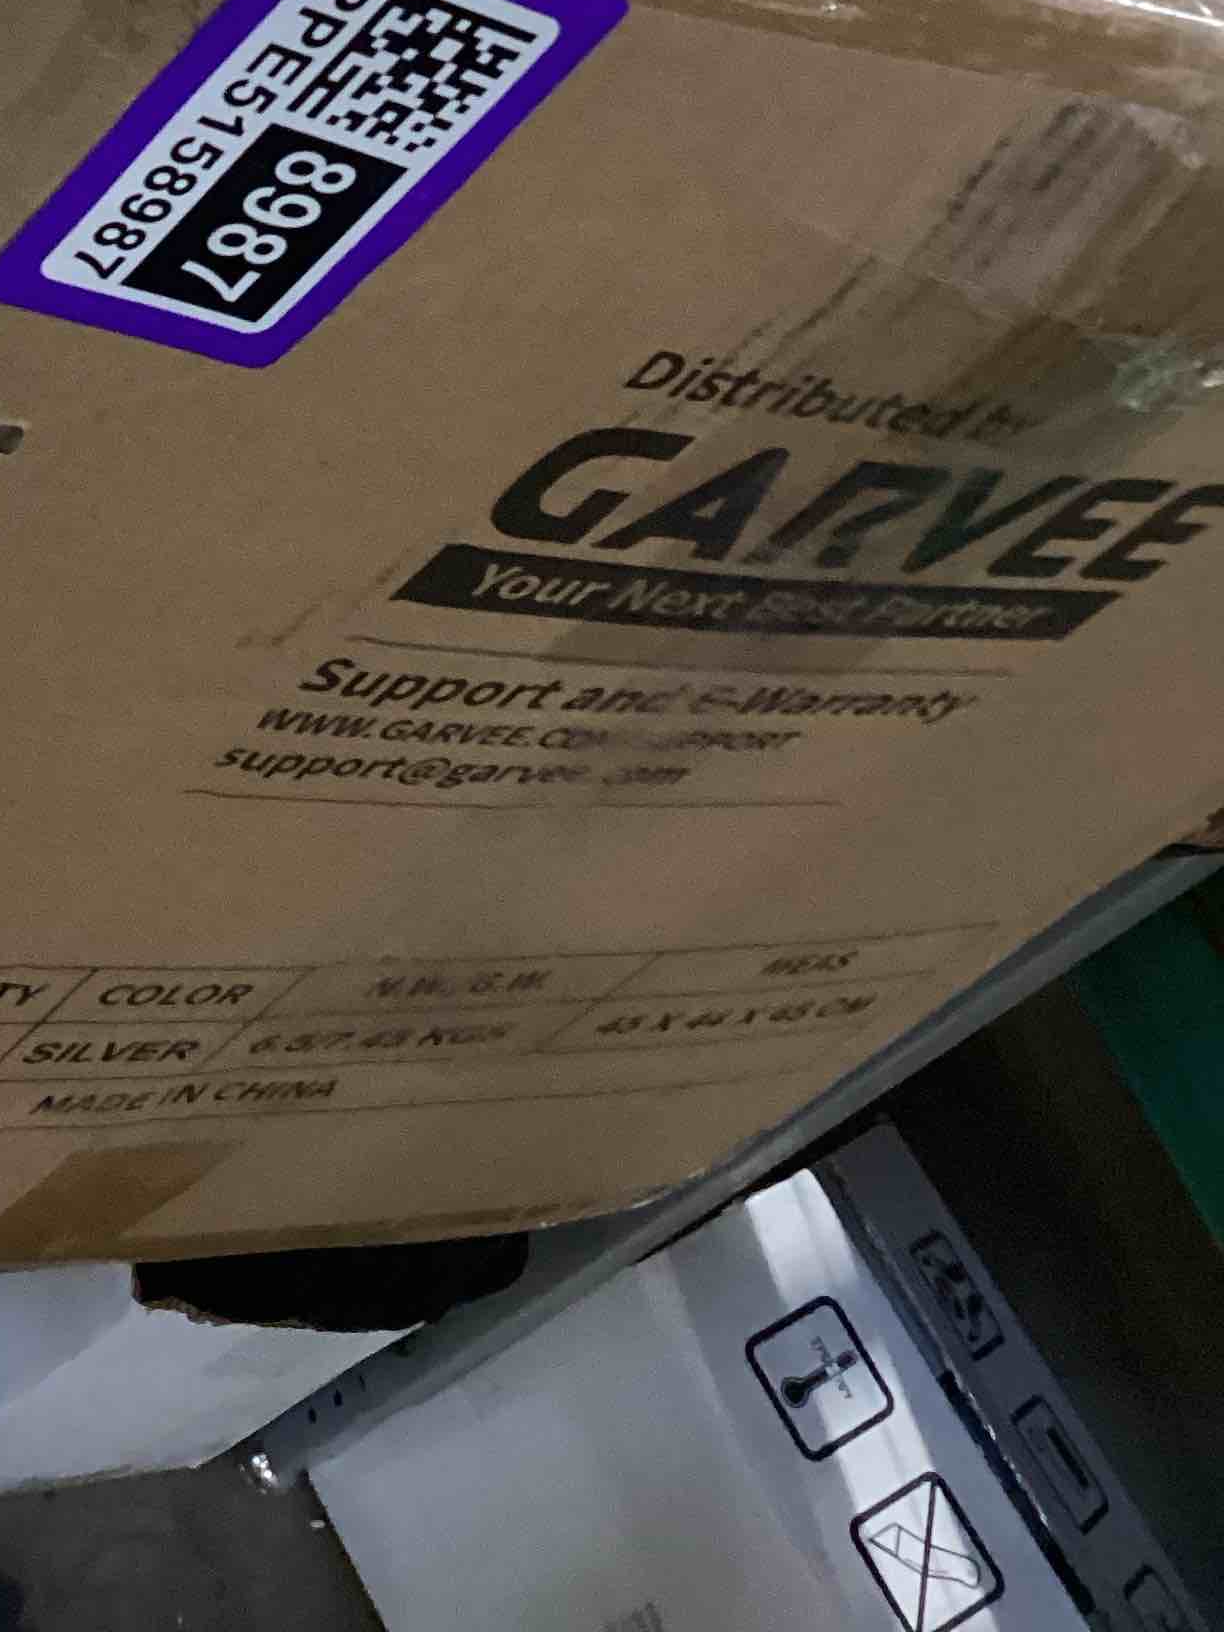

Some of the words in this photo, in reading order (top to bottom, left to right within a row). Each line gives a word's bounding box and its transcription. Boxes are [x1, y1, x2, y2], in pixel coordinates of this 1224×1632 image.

[181, 148, 358, 304] 8987
[624, 350, 979, 439] Distributed
[489, 426, 1224, 582] GARVEE
[472, 562, 615, 607] Your
[610, 579, 751, 620] Next
[865, 592, 1054, 631] Partner
[298, 657, 564, 711] Support
[560, 682, 690, 714] and
[97, 982, 256, 1007] COLOR
[21, 1039, 202, 1065] SILVER
[28, 1089, 157, 1115] MADE
[154, 1081, 210, 1108] IN
[211, 1078, 340, 1103] CHINA
